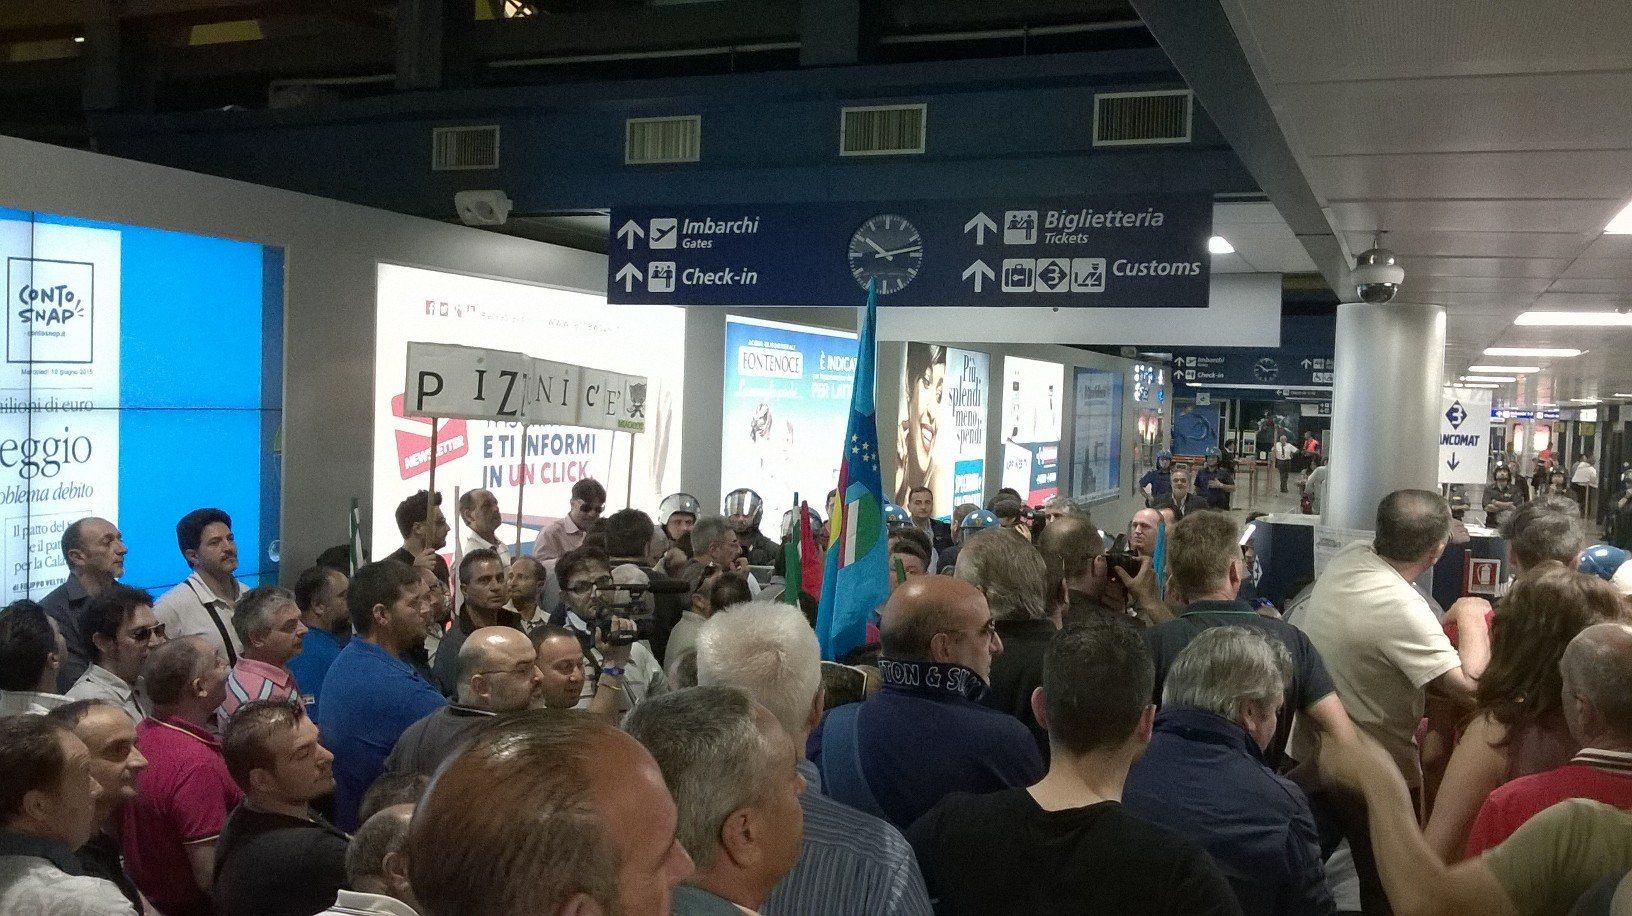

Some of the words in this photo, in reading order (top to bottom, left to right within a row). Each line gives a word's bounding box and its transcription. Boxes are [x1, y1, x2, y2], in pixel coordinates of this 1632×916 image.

[682, 216, 760, 234] Imbarchi
[1045, 208, 1165, 232] Biglietteria
[682, 238, 713, 249] Gates
[1045, 232, 1089, 244] Tickets
[682, 267, 758, 285] Check-in
[1112, 259, 1201, 276] Customs
[19, 284, 74, 307] CONTO
[18, 308, 74, 326] SNAP
[743, 352, 800, 374] FONTENOCE
[963, 354, 976, 382] Più
[45, 396, 59, 412] di
[62, 400, 93, 411] euro
[949, 376, 981, 416] splendi
[0, 426, 92, 480] eggio
[484, 435, 493, 458] E
[498, 435, 515, 458] TI
[522, 433, 596, 457] NFORMI
[483, 464, 502, 488] IN
[509, 462, 535, 487] UN
[53, 481, 93, 500] debito
[50, 520, 65, 533] del
[34, 557, 42, 570] la
